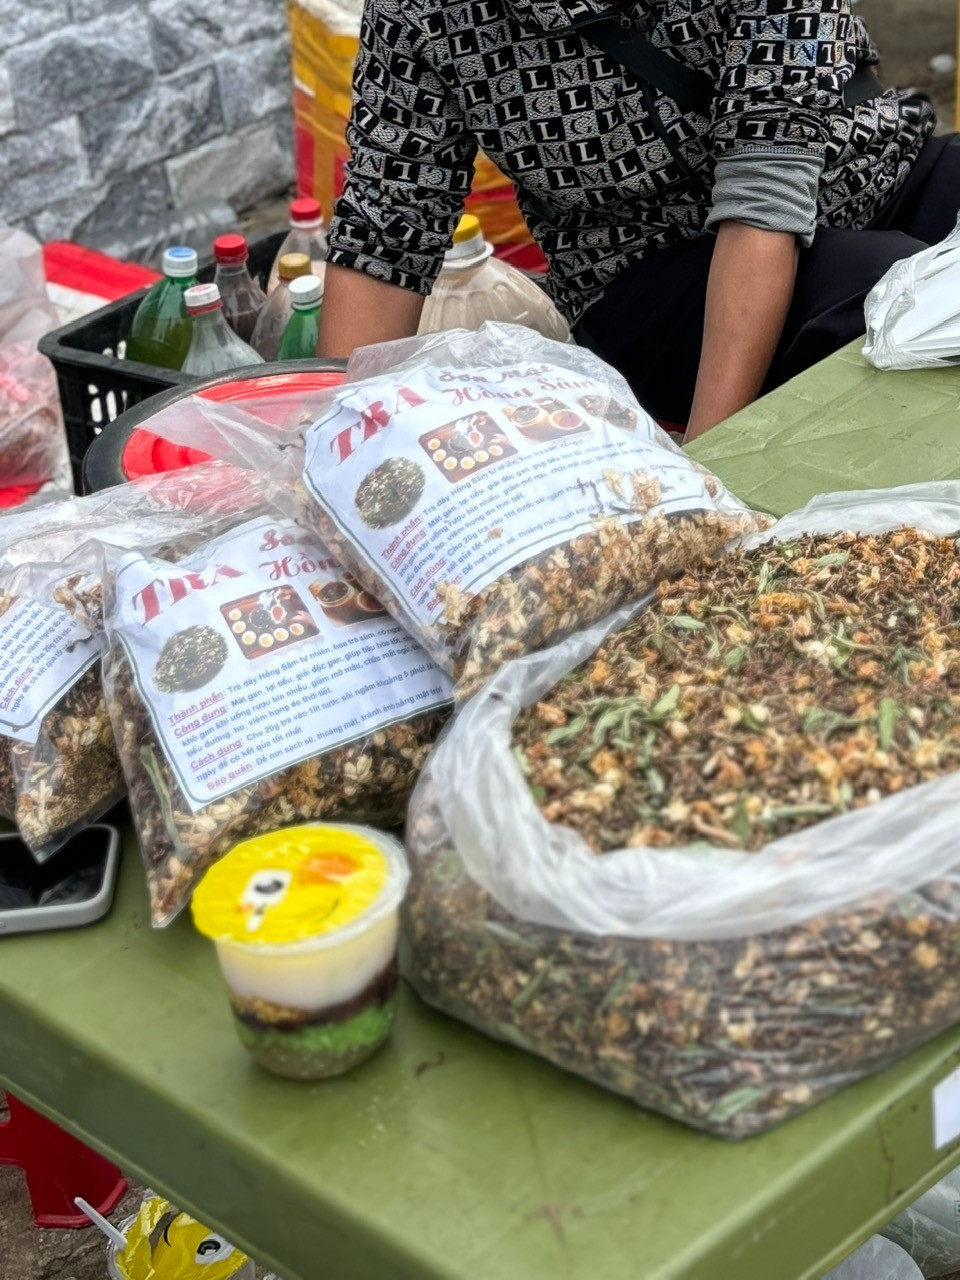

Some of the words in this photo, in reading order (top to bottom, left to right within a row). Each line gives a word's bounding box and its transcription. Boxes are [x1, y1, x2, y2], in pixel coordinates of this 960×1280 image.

[447, 543, 463, 557] Cho
[463, 532, 479, 545] 20g
[31, 650, 46, 664] Cho
[344, 648, 361, 662] giúp
[227, 684, 242, 694] Trà
[243, 677, 257, 687] dây
[248, 714, 268, 727] viêm
[291, 699, 301, 708] do
[215, 717, 229, 729] khi
[246, 731, 264, 741] Cho
[264, 723, 280, 735] 20g
[271, 733, 284, 744] tốt
[284, 725, 303, 738] nhất
